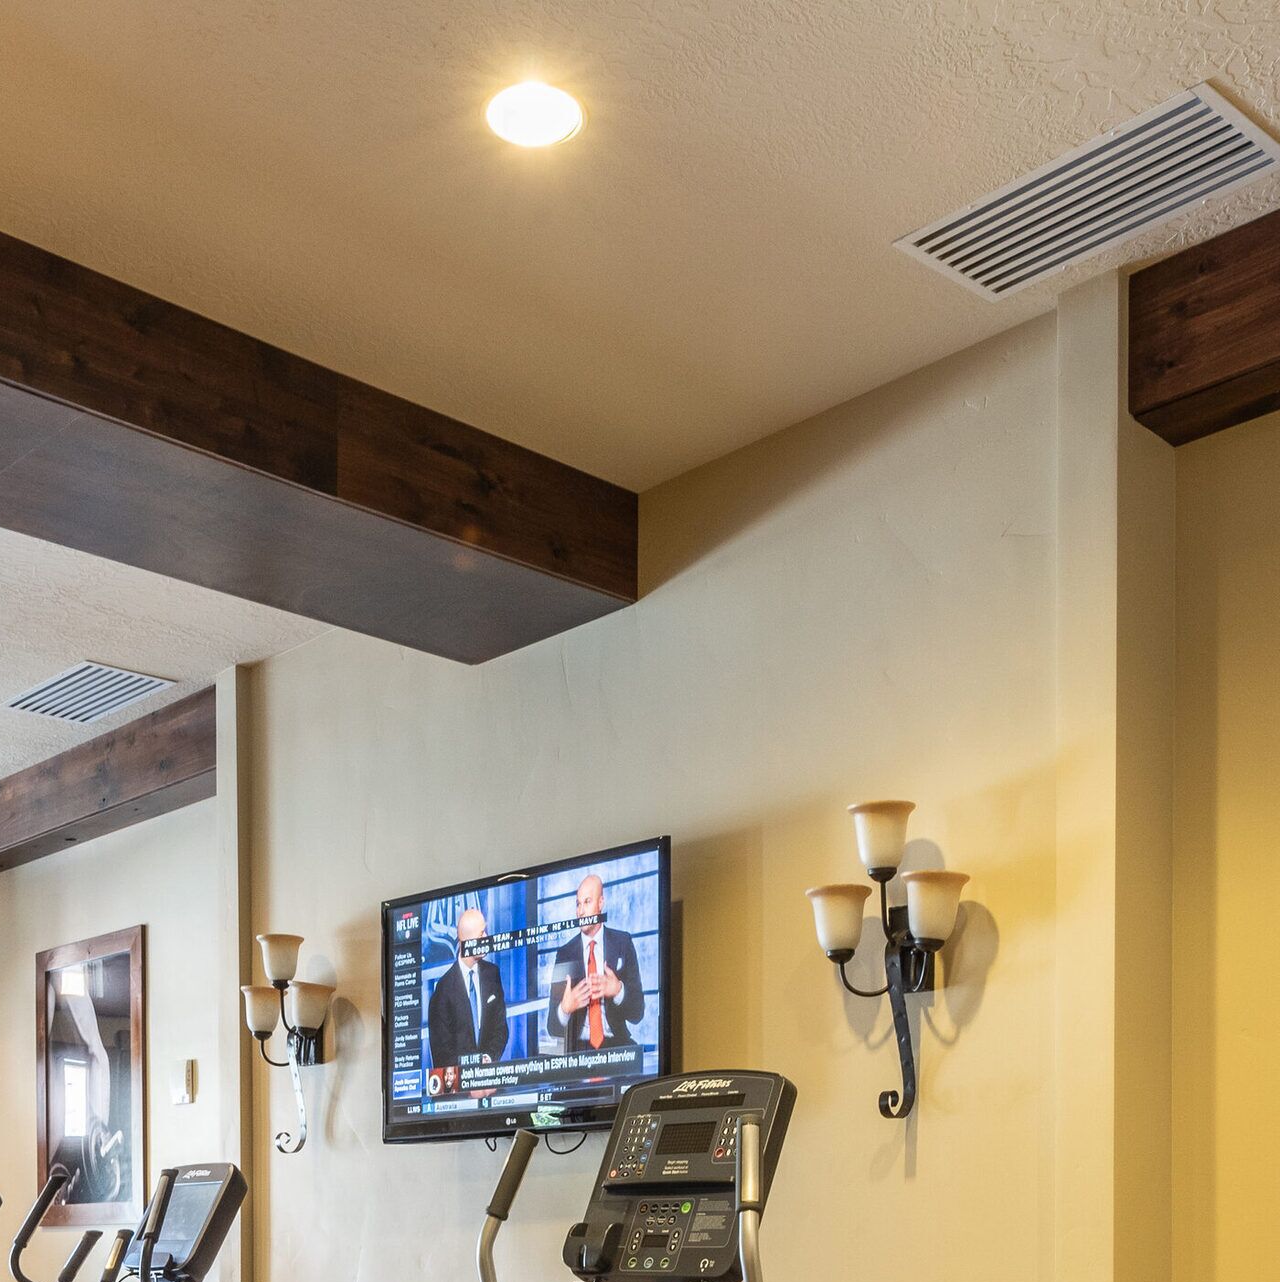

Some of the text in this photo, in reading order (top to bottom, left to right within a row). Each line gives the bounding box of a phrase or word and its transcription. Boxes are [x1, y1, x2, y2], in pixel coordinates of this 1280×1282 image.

[464, 939, 477, 949] AND
[527, 926, 549, 936] THINK
[552, 921, 575, 931] HE'LL
[579, 915, 598, 926] HAVE
[472, 946, 490, 956] GOOD
[493, 943, 510, 952] YEAR
[515, 940, 523, 948] IN
[461, 1050, 636, 1080] Josh Norman covers everything in ESPN the Magazine Interview
[461, 1079, 470, 1089] On
[501, 1075, 519, 1086] Friday
